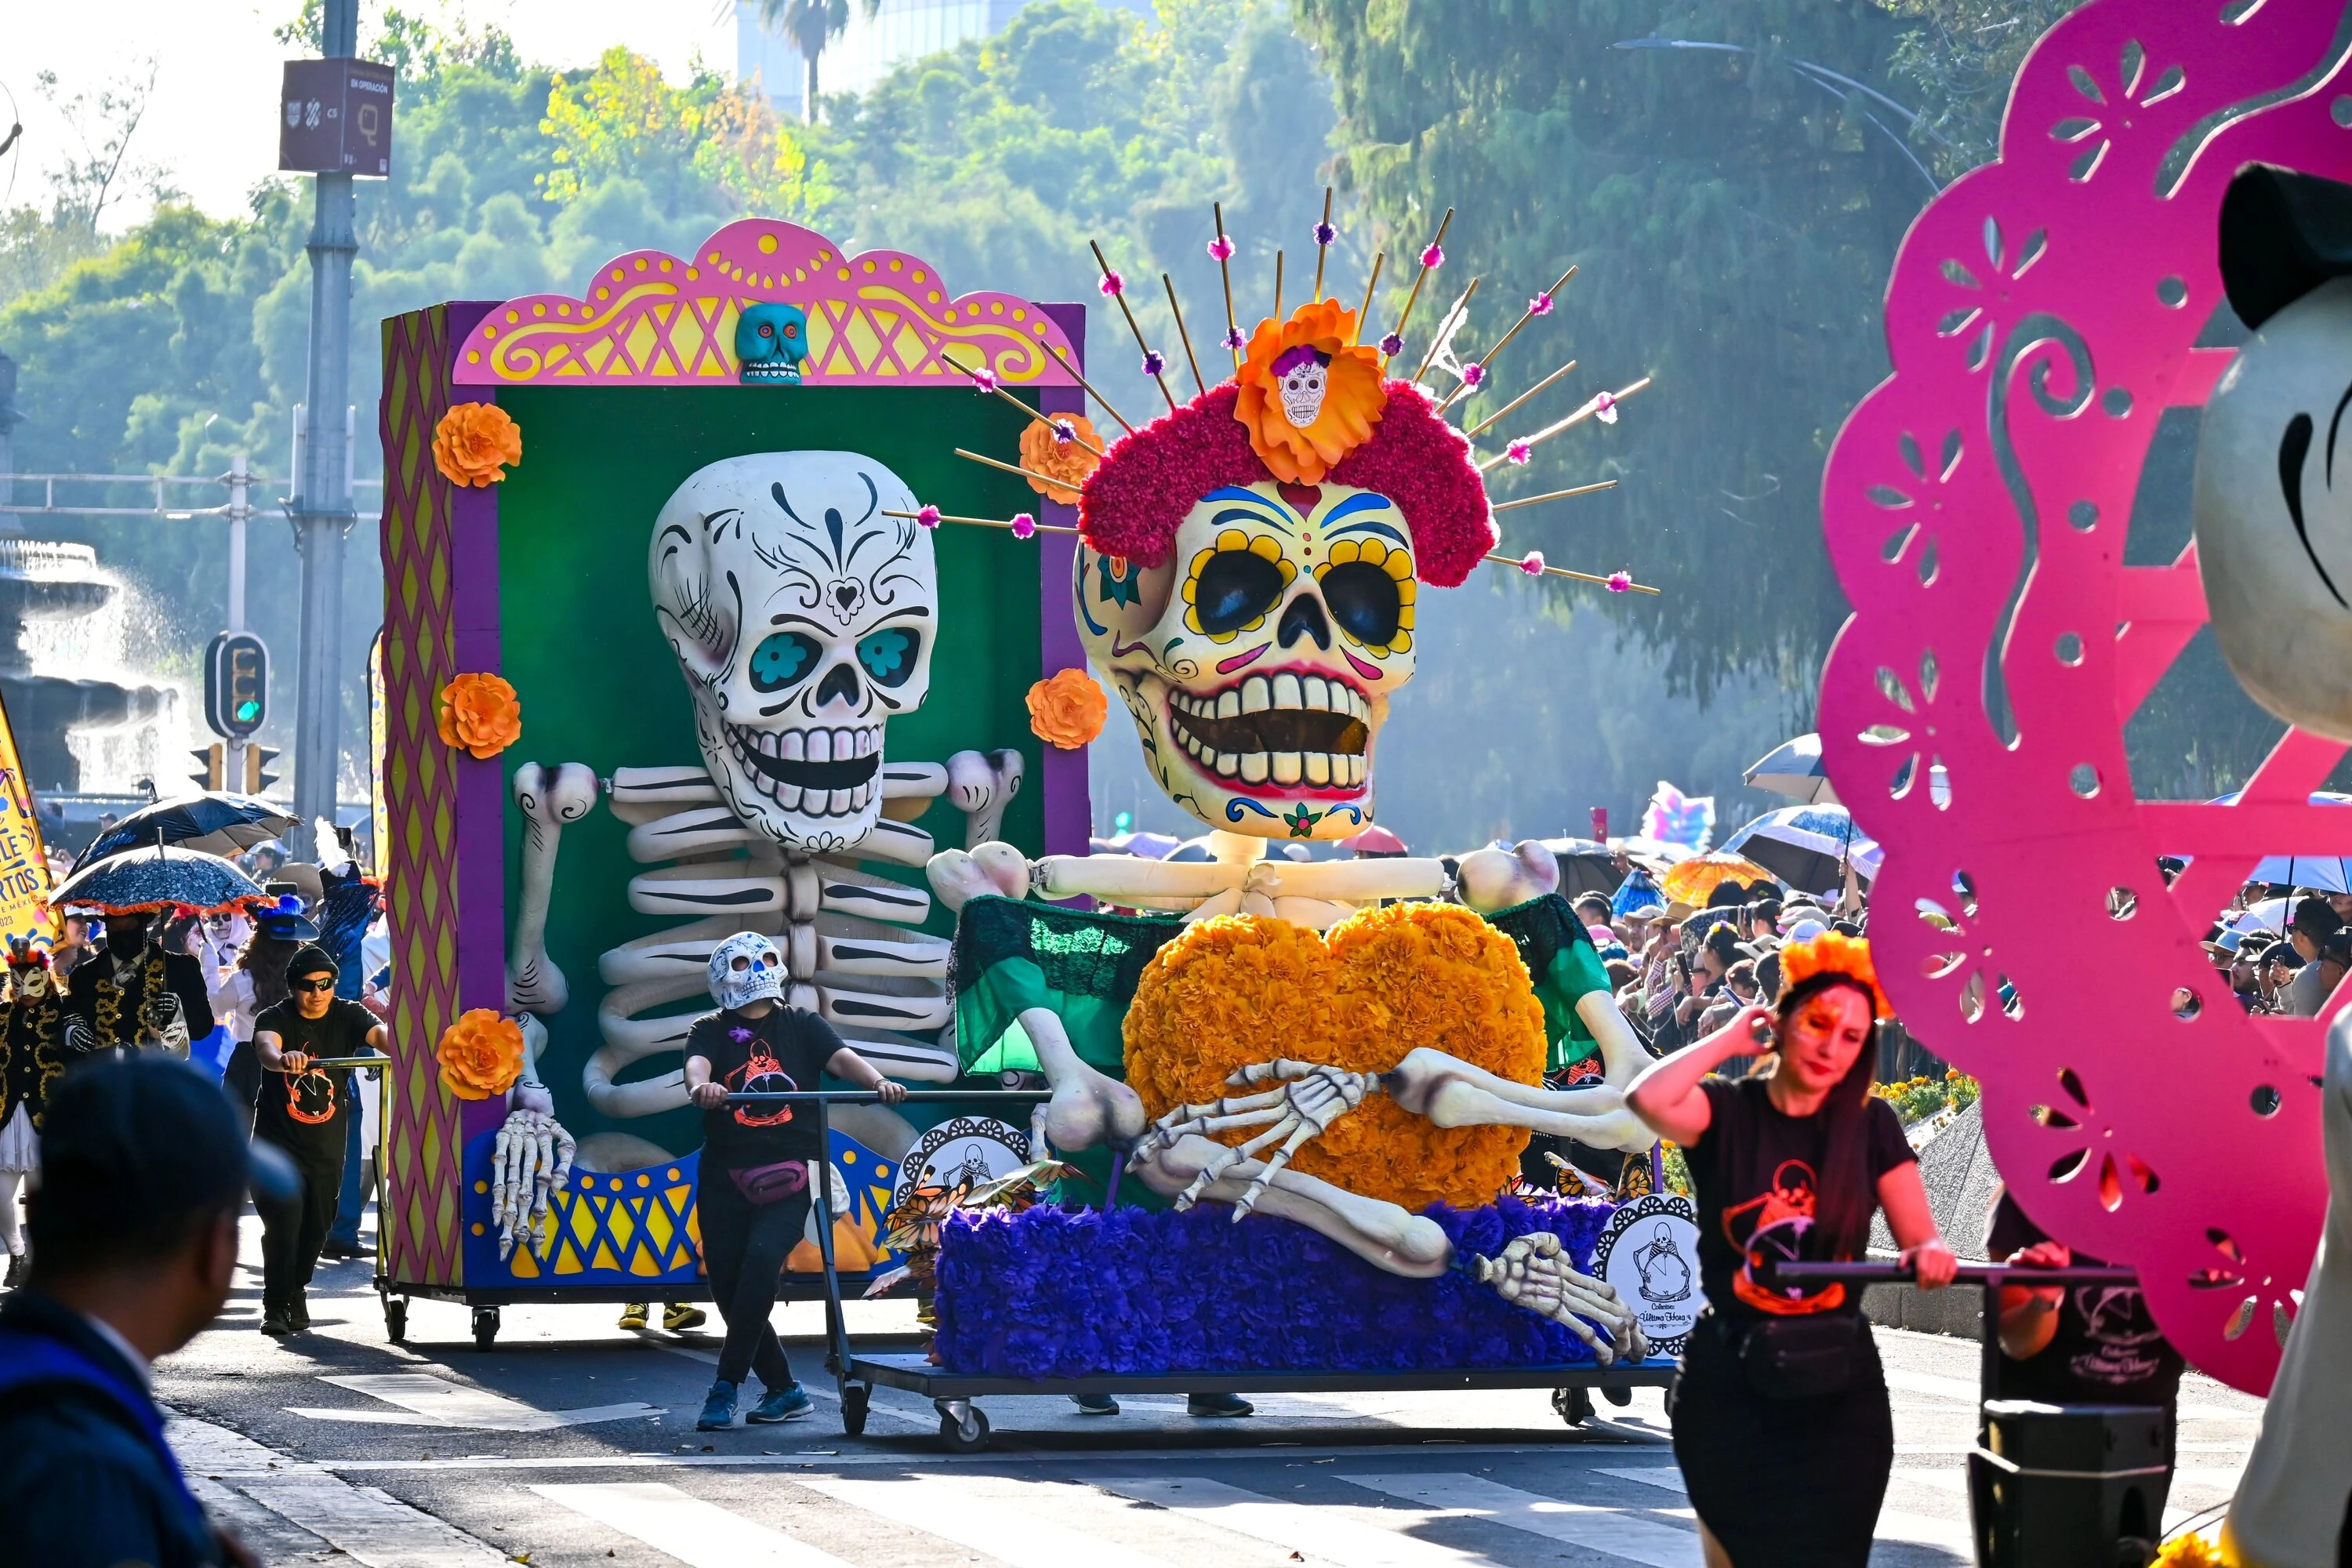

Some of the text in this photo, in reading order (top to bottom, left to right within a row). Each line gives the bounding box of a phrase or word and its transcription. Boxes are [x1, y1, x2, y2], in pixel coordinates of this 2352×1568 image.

[358, 80, 388, 94] OPERACIÓN
[0, 835, 22, 862] LE
[1639, 1311, 1686, 1322] Última Hora
